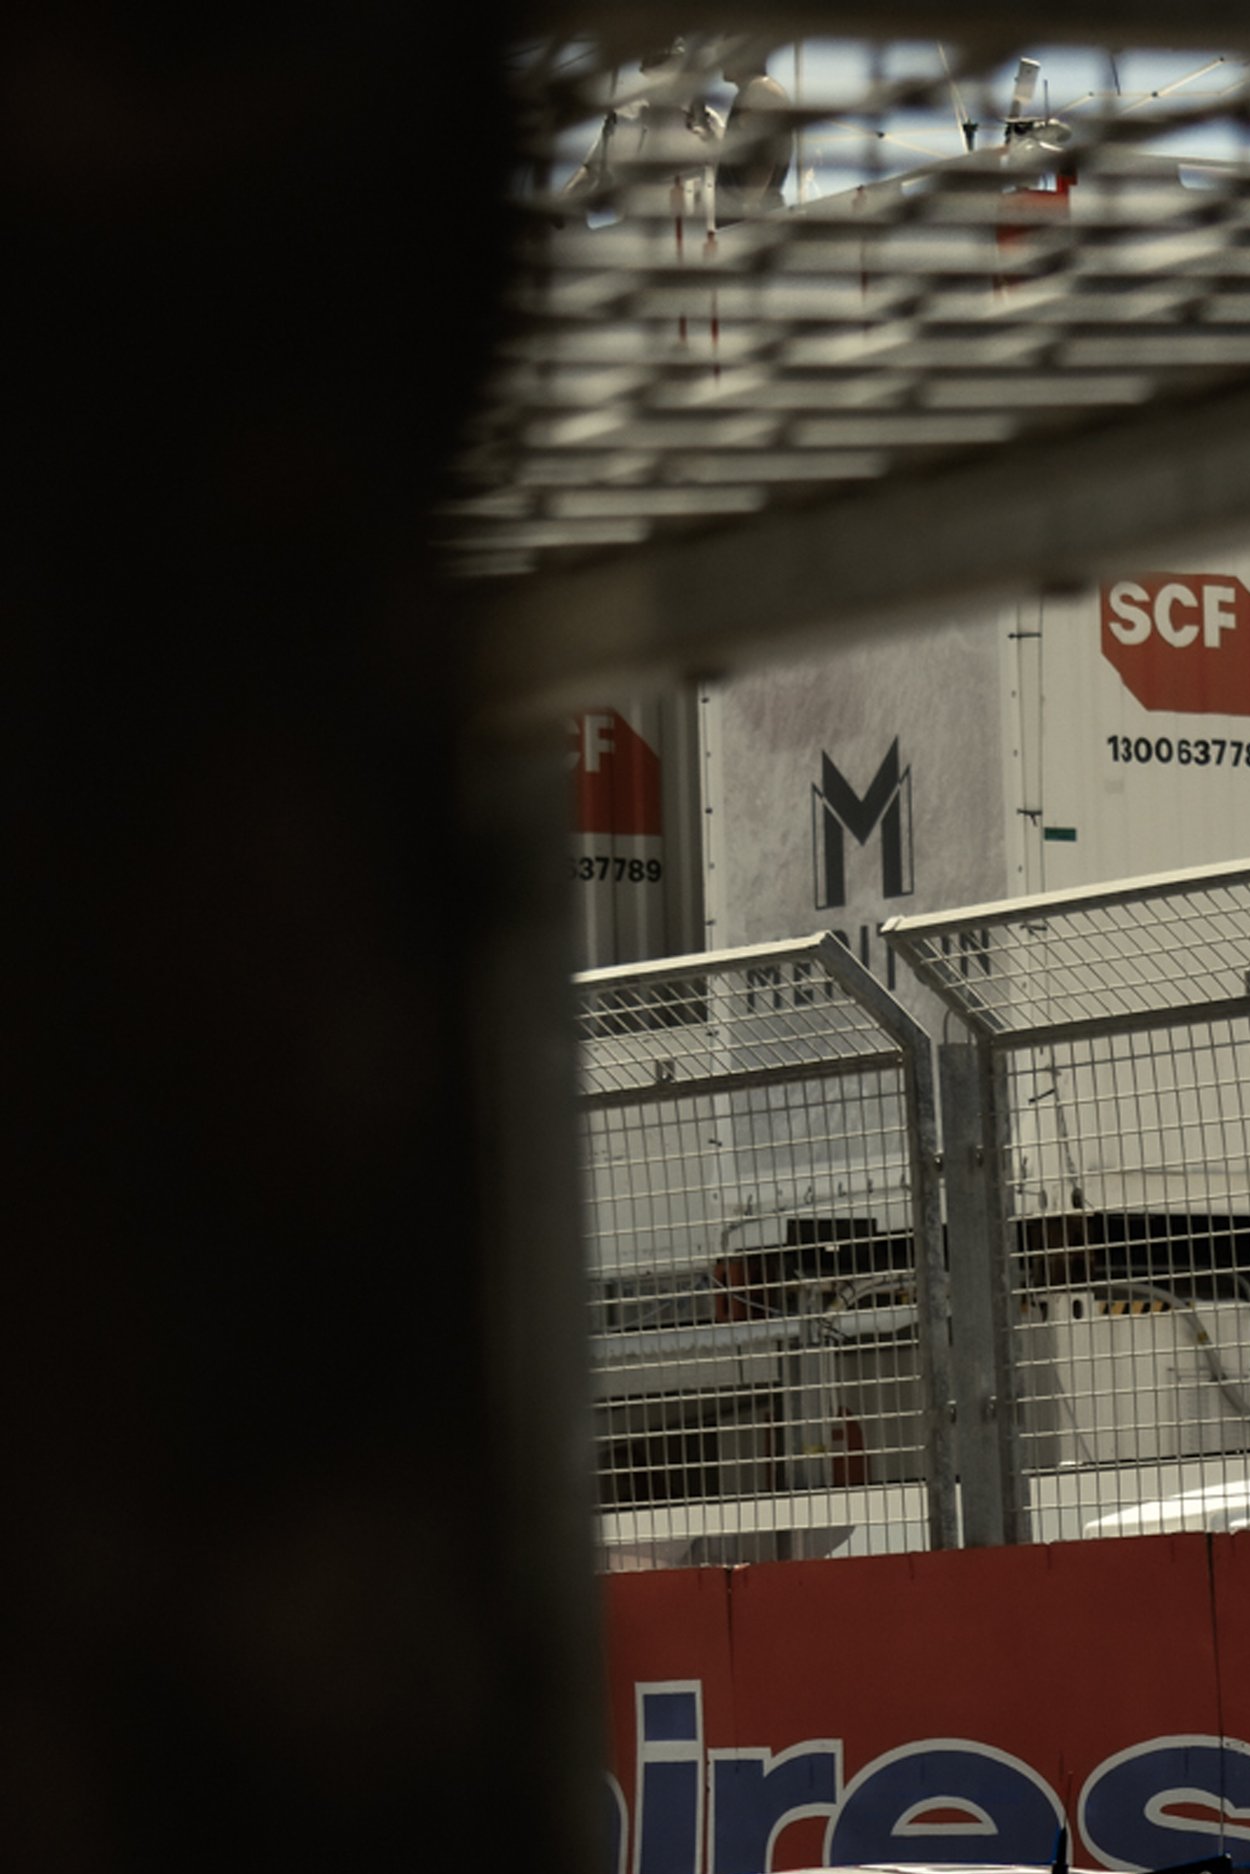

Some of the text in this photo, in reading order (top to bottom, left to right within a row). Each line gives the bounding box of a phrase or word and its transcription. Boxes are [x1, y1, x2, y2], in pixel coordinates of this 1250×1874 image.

[1108, 581, 1236, 648] SCF
[811, 733, 914, 910] M
[571, 856, 662, 883] 37789
